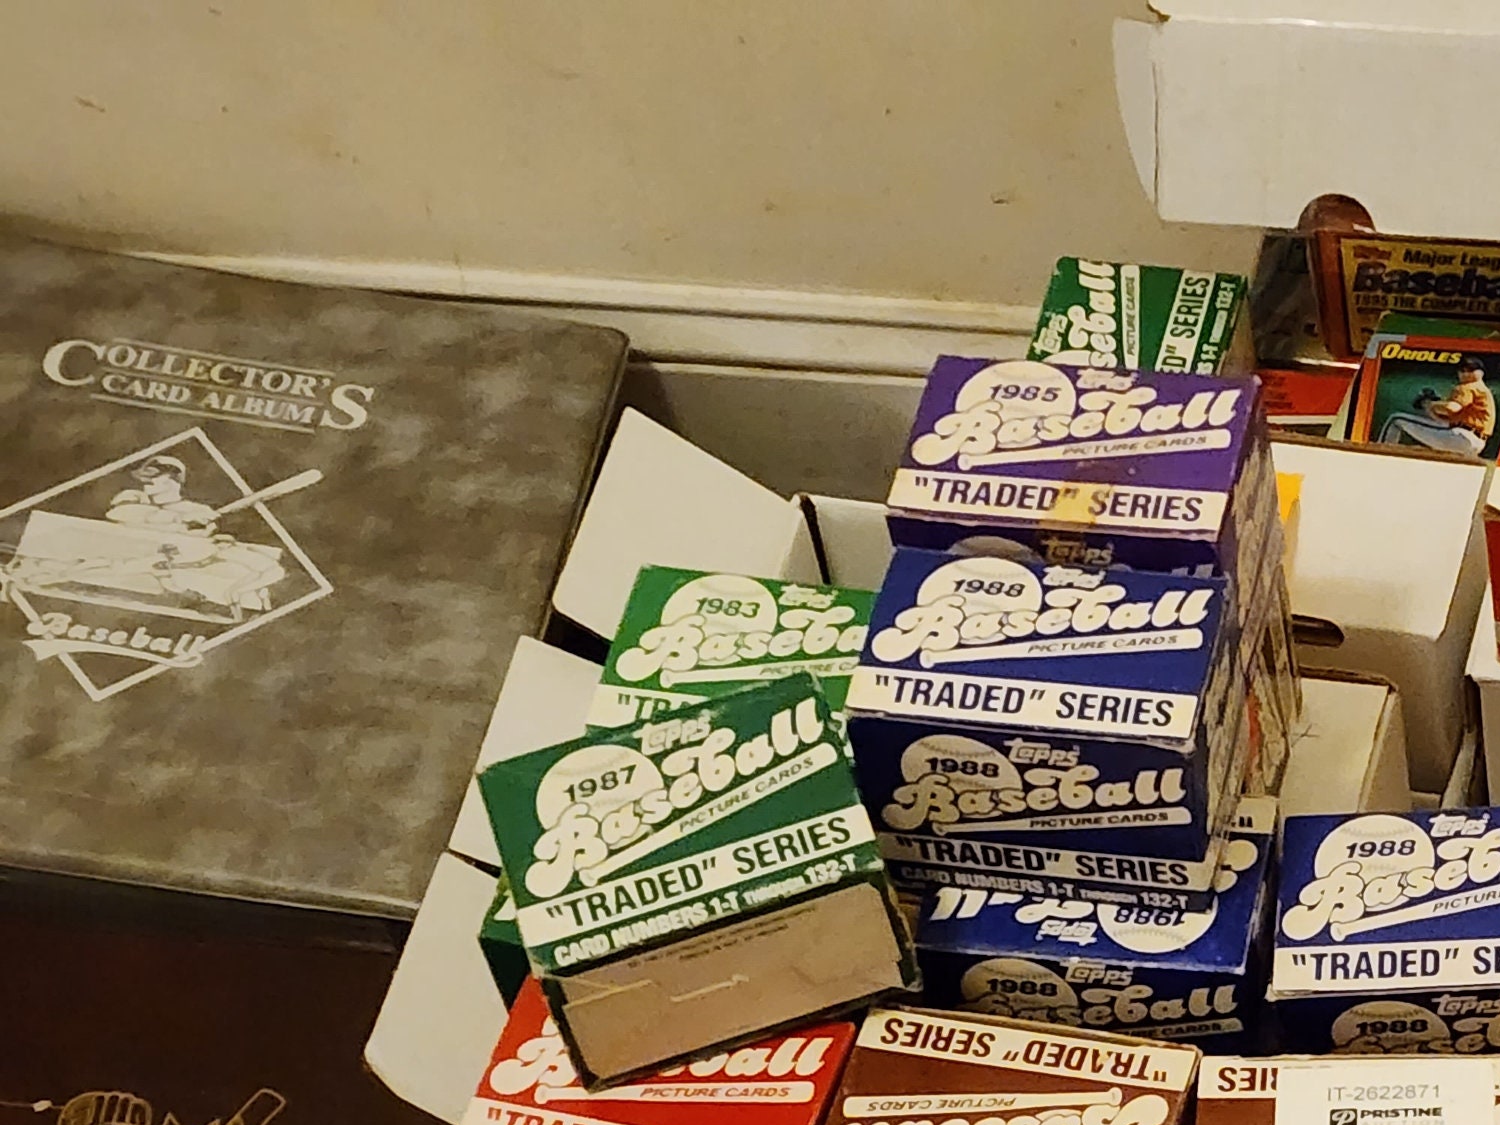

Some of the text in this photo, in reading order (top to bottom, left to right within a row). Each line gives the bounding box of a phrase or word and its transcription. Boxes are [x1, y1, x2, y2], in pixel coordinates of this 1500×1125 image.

[1403, 250, 1456, 266] Major
[1170, 276, 1211, 339] SERIES
[1382, 343, 1462, 364] ORIOLES
[43, 339, 374, 430] COLLECTOR'S
[101, 374, 316, 425] CARD ALBUM
[989, 383, 1061, 402] 1985
[911, 388, 1242, 466] Baseball
[1062, 435, 1208, 457] PICTURE CARDS
[914, 476, 1203, 522] "TRADED" SERIES
[952, 578, 1025, 598] 1988
[695, 597, 760, 618] 1983
[871, 585, 1213, 662] Baseball
[27, 612, 207, 654] Baseball
[1027, 634, 1178, 654] PICTURE CARDS
[874, 674, 1174, 727] "TRADED" SERIES
[925, 756, 1000, 777] 1988
[524, 698, 824, 899] Baseball
[562, 764, 638, 803] 1987
[679, 756, 815, 833] PICTURE CARDS
[882, 765, 1187, 829] Baseball
[1346, 839, 1417, 858] 1988
[546, 816, 851, 929] "TRADED" SERIES
[1076, 854, 1189, 886] SERIES
[954, 872, 1189, 910] NUMBERS 132-T
[553, 930, 609, 967] CARD
[612, 900, 709, 952] NUMBERS
[802, 854, 857, 891] 132-T
[1291, 947, 1460, 980] "TRADED"
[986, 978, 1058, 996] 1988
[879, 1017, 996, 1057] SERIES
[1355, 1018, 1430, 1035] 1988
[640, 1086, 792, 1098] PICTURE CARDS
[867, 1097, 1017, 1112] PICTURE CARDS
[1328, 1085, 1440, 1101] IT-2622871
[1360, 1107, 1442, 1119] PRISTINE
